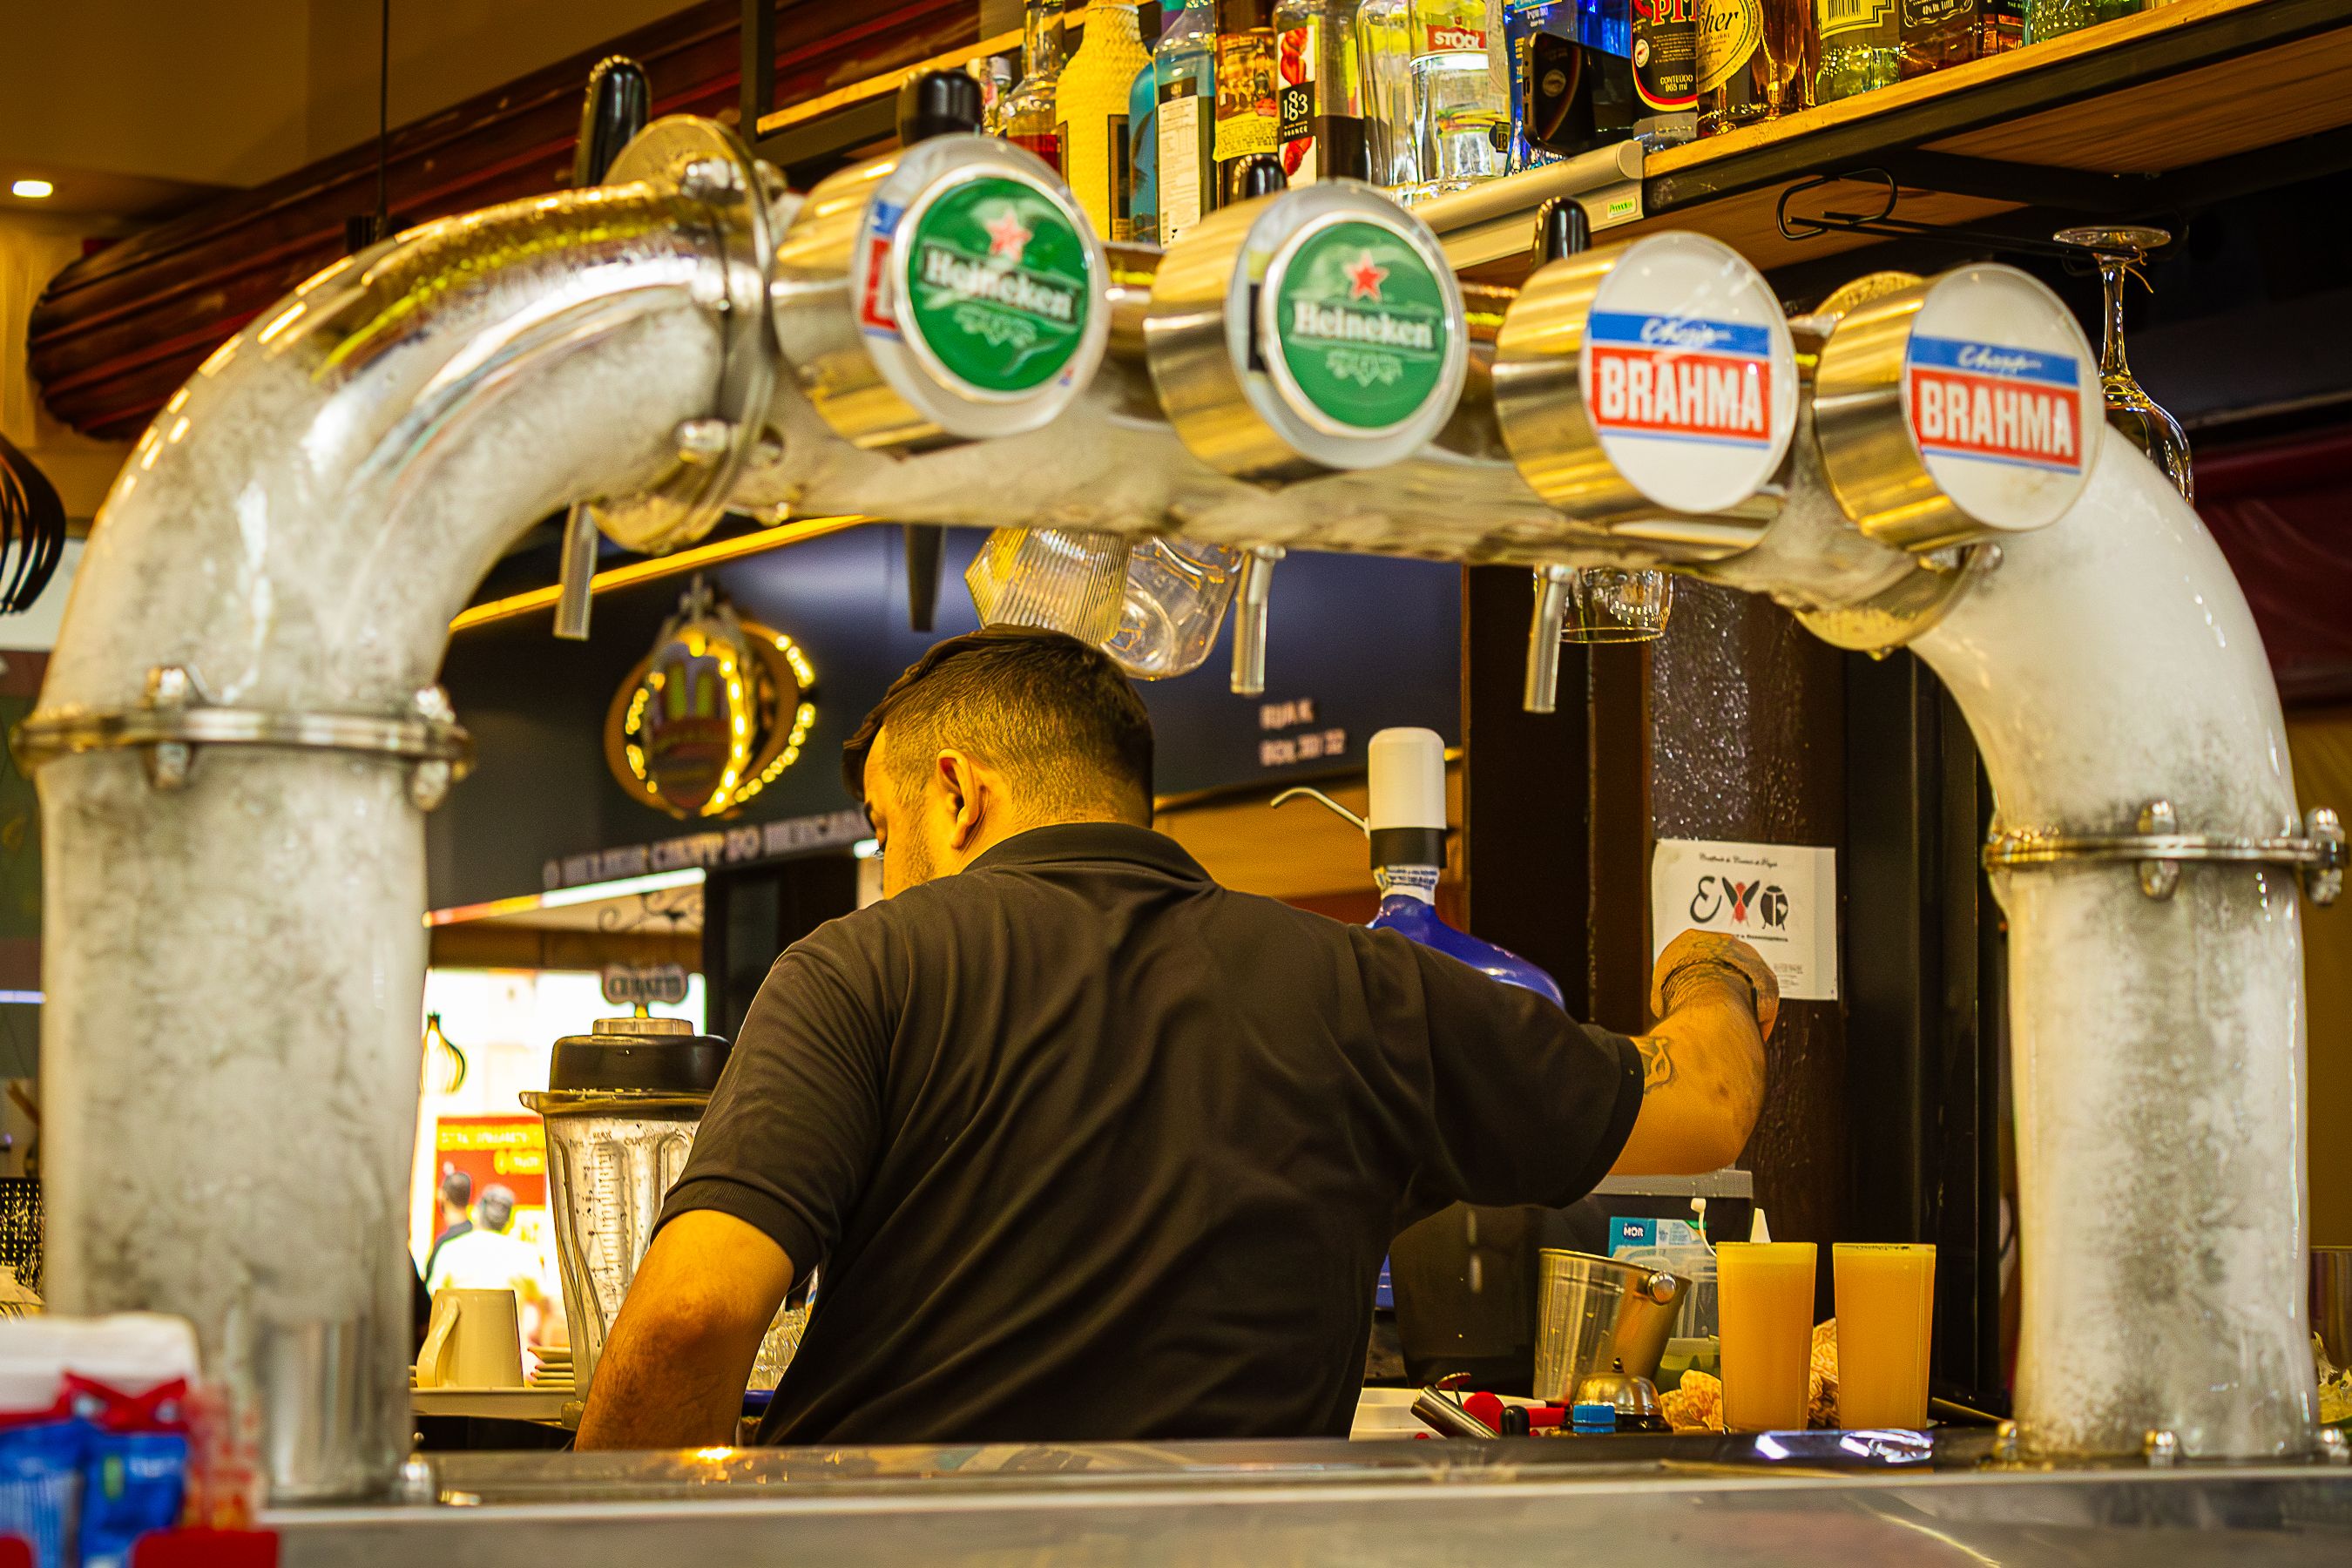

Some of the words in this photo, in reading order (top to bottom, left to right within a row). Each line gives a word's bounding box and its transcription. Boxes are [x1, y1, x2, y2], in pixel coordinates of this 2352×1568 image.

[924, 249, 1072, 321] Heineken
[1294, 301, 1433, 349] Heineken
[1599, 355, 1763, 431] BRAHMA
[1919, 379, 2074, 457] BRAHMA
[1623, 1226, 1644, 1238] MOR
